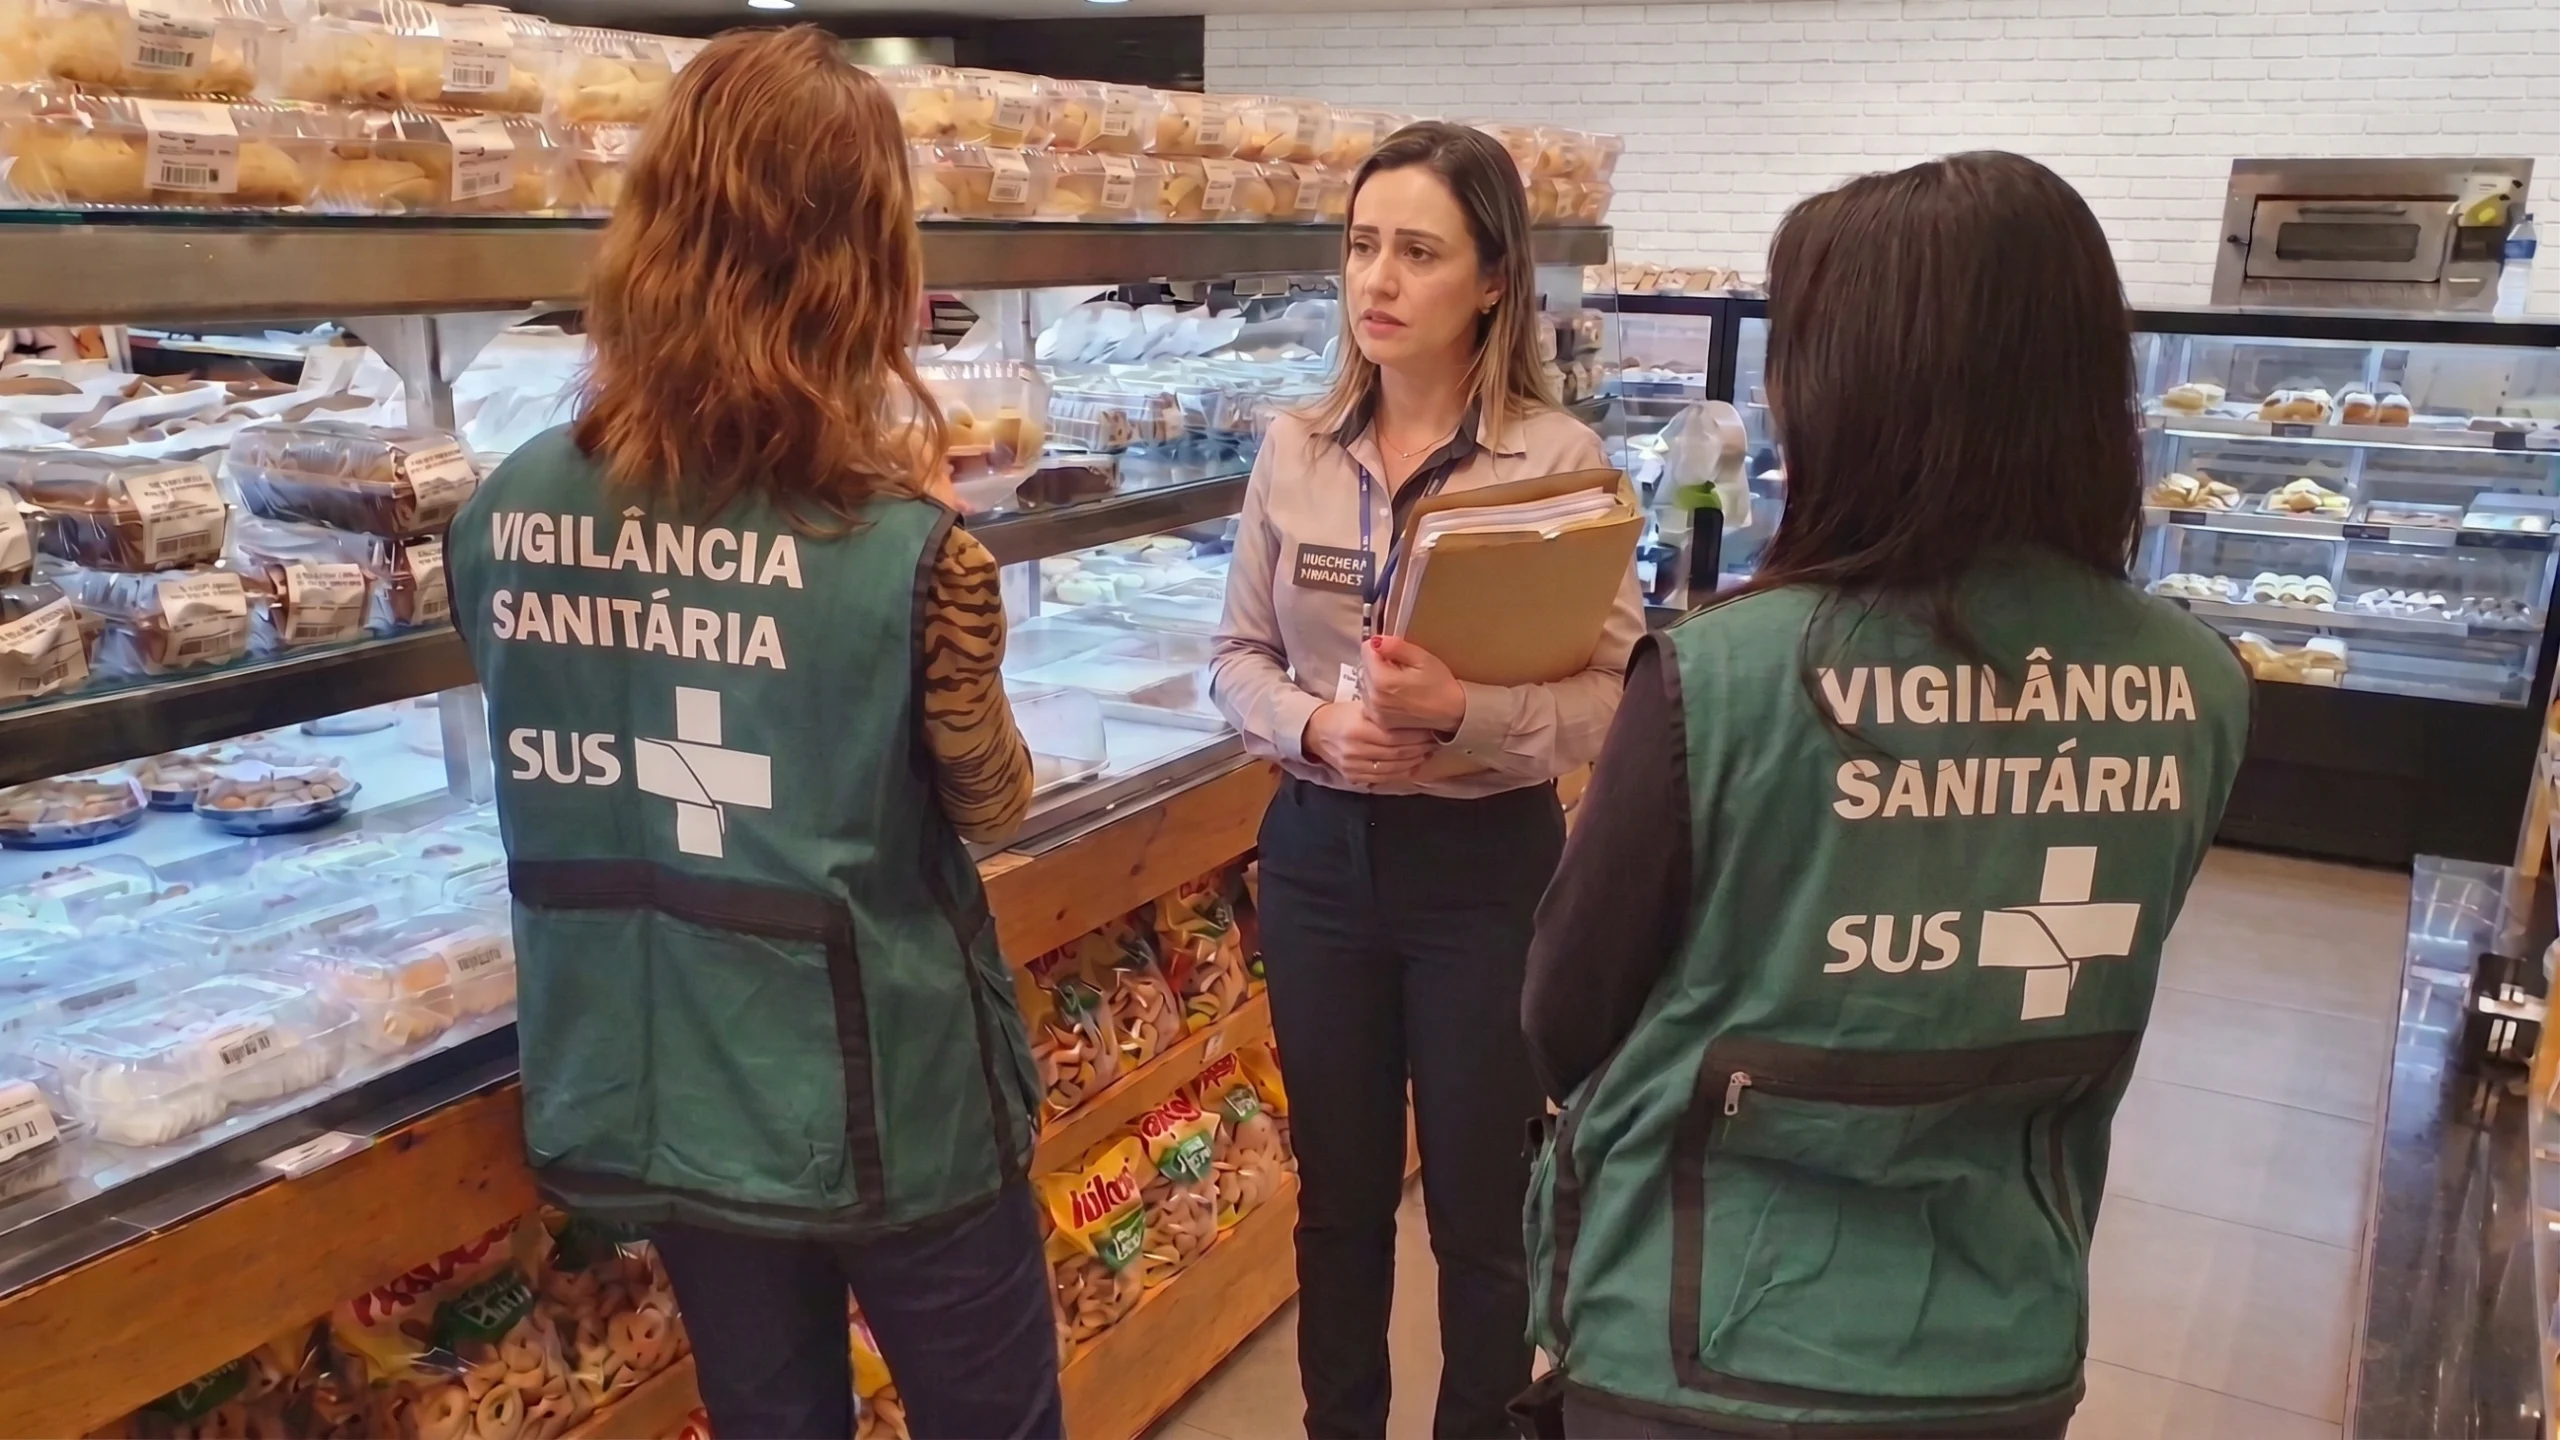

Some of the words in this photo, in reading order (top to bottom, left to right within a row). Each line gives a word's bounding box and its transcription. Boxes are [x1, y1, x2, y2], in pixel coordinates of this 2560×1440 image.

[492, 505, 803, 589] VIGILÂNCIA
[492, 588, 787, 670] SANITÁRIA
[1816, 647, 2197, 725] VIGILÂNCIA
[508, 727, 622, 787] SUS
[1833, 737, 2182, 819] SANITÁRIA
[1823, 911, 1962, 974] SUS
